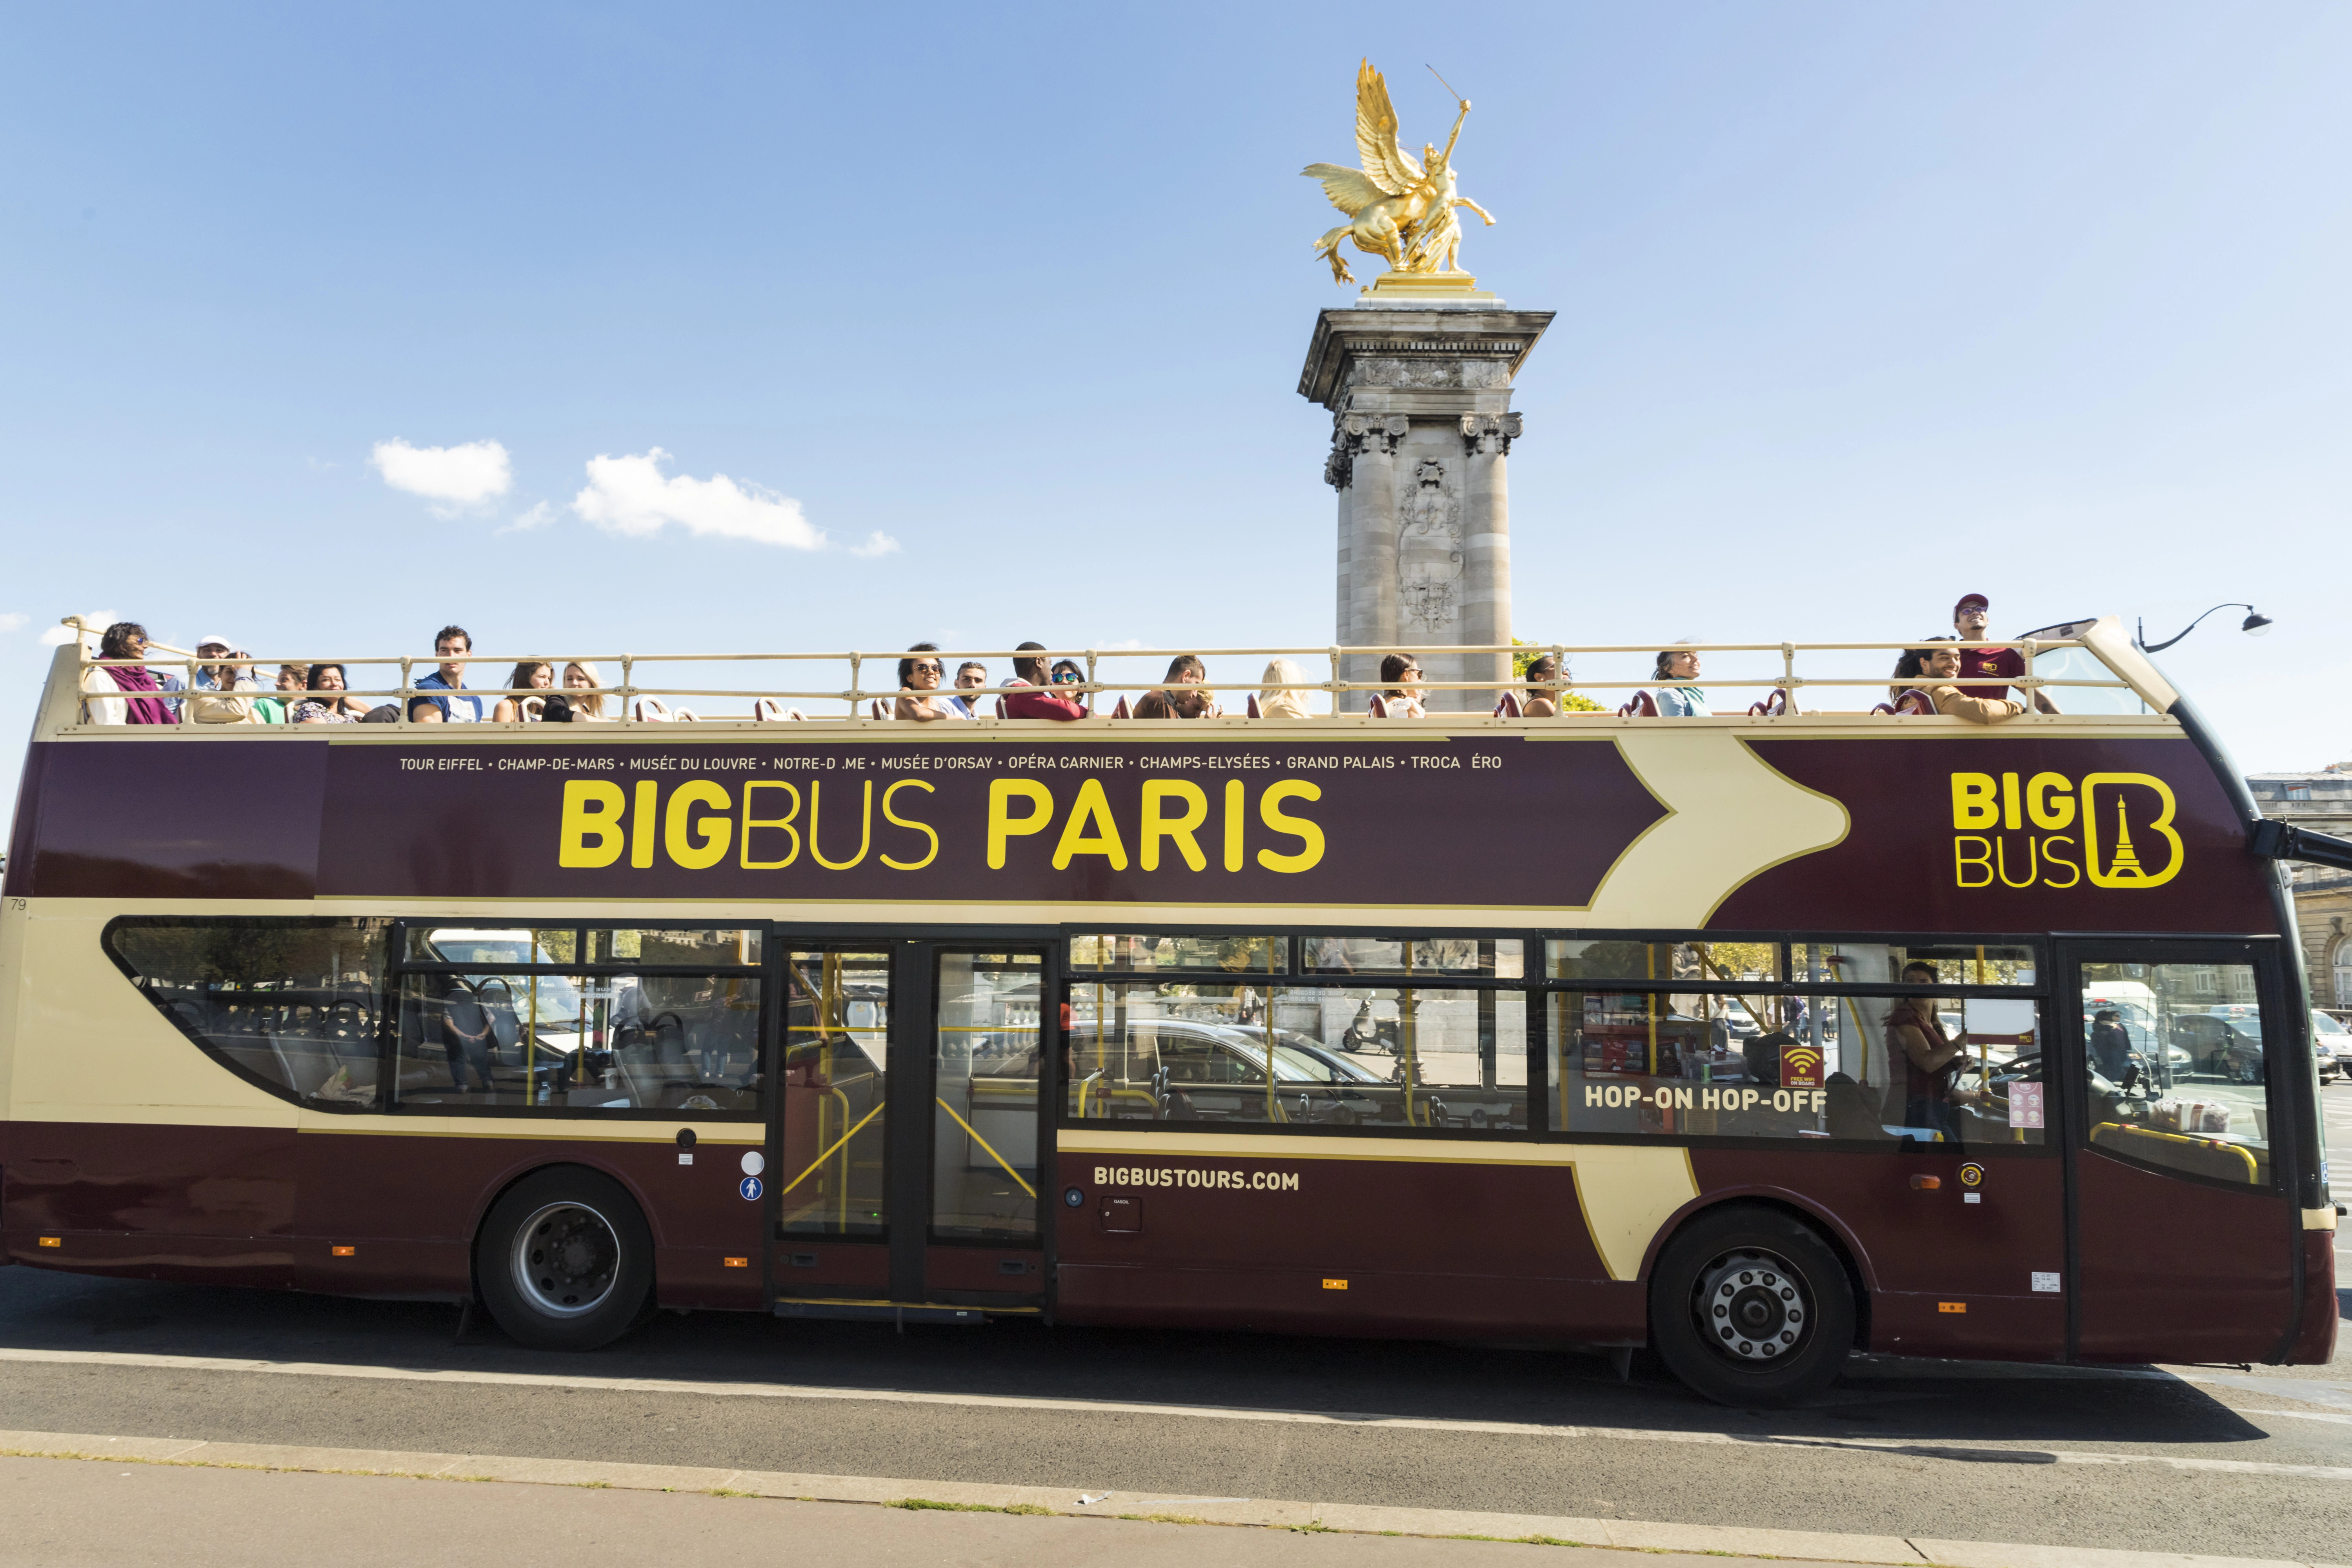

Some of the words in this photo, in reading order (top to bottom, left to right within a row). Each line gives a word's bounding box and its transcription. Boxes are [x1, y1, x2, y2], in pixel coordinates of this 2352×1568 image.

[400, 759, 434, 770] TOUR
[438, 759, 483, 770] EIFFEL
[498, 758, 615, 770] CHAMP-DE-MARS
[681, 758, 699, 770] DU
[704, 758, 757, 770] LOUVRE
[882, 754, 930, 769] MUSÉE
[934, 757, 993, 769] D'ORSAY
[1009, 753, 1056, 769] OPÉRA
[1140, 753, 1270, 769] CHAMPS-ELYSÉES
[1287, 757, 1338, 769] GRAND
[1344, 756, 1395, 768] PALAIS
[1951, 772, 2076, 830] BIG
[987, 779, 1325, 873] PARIS
[1955, 836, 2080, 888] BUS
[12, 899, 26, 910] 79
[1585, 1085, 1693, 1109] HOP-ON
[1703, 1088, 1827, 1113] HOP-OFF
[1094, 1167, 1299, 1191] BIGBUSTOURS.COM
